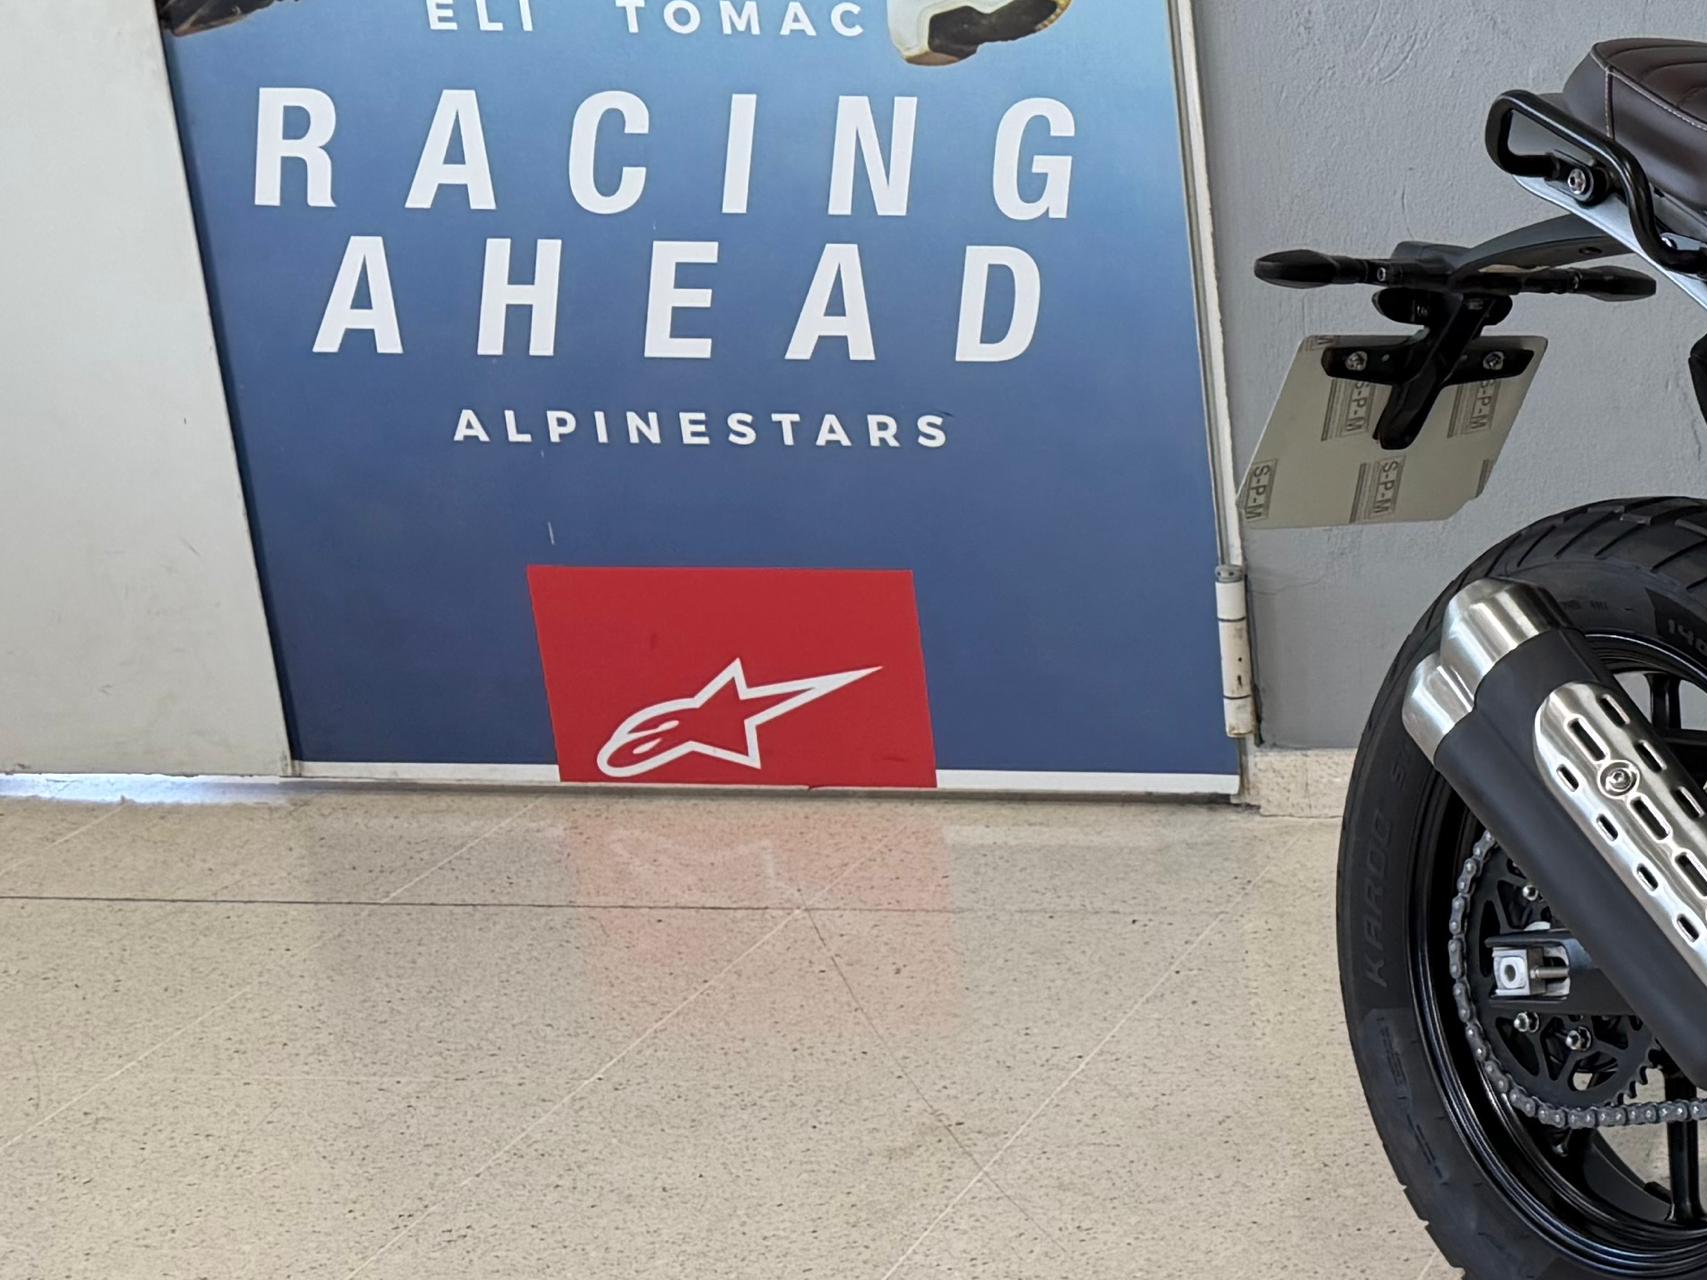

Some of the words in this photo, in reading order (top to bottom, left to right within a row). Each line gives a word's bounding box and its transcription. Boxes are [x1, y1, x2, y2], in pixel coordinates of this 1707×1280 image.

[252, 86, 1076, 221] RACING
[311, 235, 1042, 363] AHEAD
[452, 408, 949, 449] ALPINESTARS
[1245, 463, 1271, 520] S-P-M
[1372, 458, 1399, 516] S-P-M
